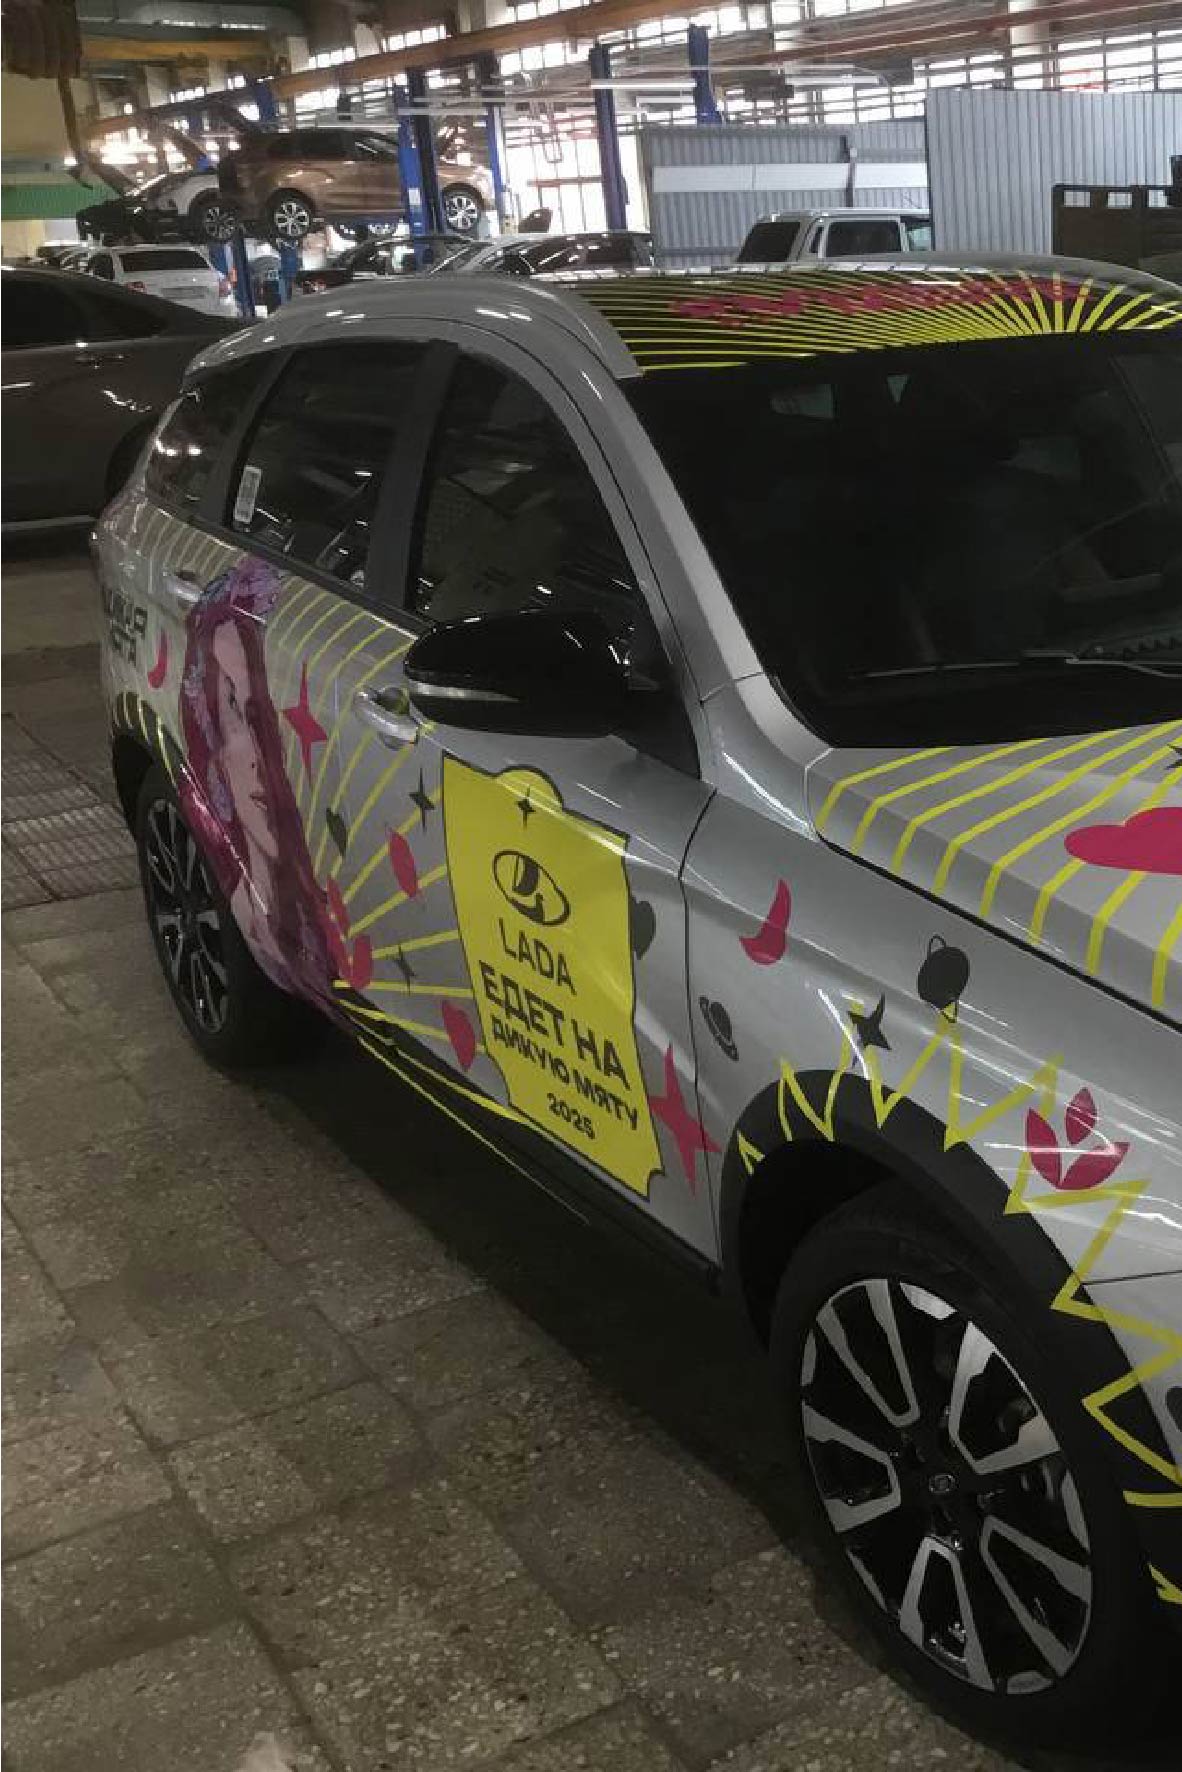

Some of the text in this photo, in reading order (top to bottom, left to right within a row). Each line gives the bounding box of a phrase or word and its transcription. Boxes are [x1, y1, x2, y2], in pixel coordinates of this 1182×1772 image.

[499, 917, 577, 996] LADA
[479, 960, 631, 1091] ЕДЕТ НА
[491, 1014, 638, 1130] ДИКУЮ МЯТУ
[547, 1092, 595, 1140] 2025
